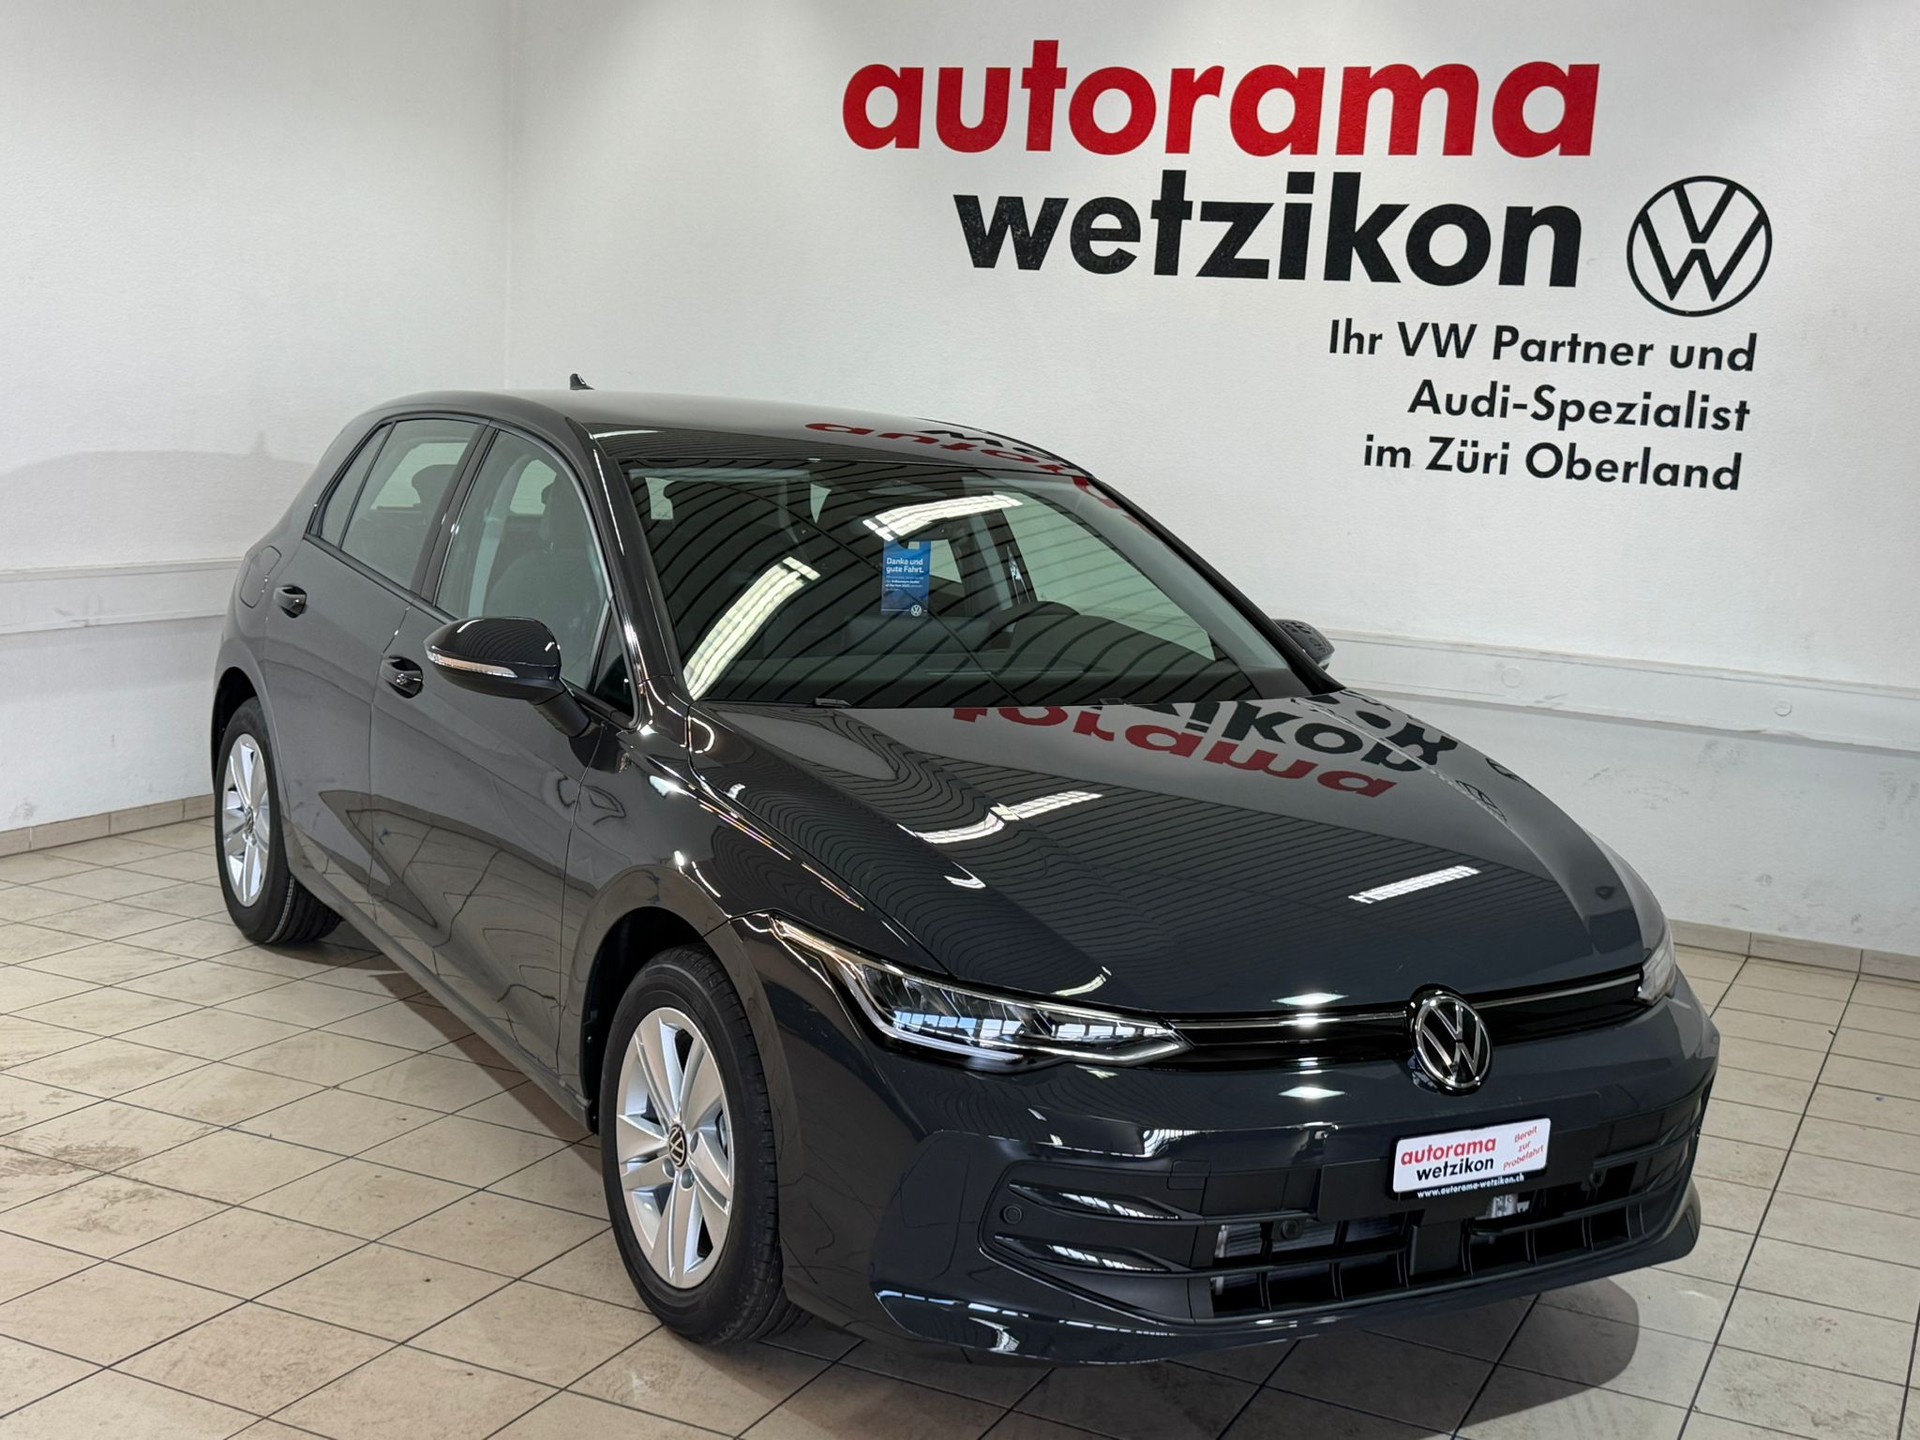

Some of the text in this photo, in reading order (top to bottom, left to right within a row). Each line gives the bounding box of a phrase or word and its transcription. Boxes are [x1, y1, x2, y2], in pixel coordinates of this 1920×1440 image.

[842, 40, 1600, 158] autorama
[953, 170, 1582, 288] wetzikon
[1329, 317, 1758, 372] Ihr VW Partner und
[1407, 379, 1751, 432] Audi-Spezialist
[1363, 434, 1743, 491] im Züri Oberland
[886, 557, 908, 565] Danke
[886, 566, 903, 574] gute
[1514, 1126, 1538, 1143] Bereit
[1517, 1140, 1532, 1153] zur
[1400, 1137, 1497, 1166] autorama
[1503, 1145, 1544, 1171] Probefahrt
[1416, 1157, 1494, 1182] wetzikon
[1416, 1172, 1525, 1199] www.autorama-wetzikon.ch
